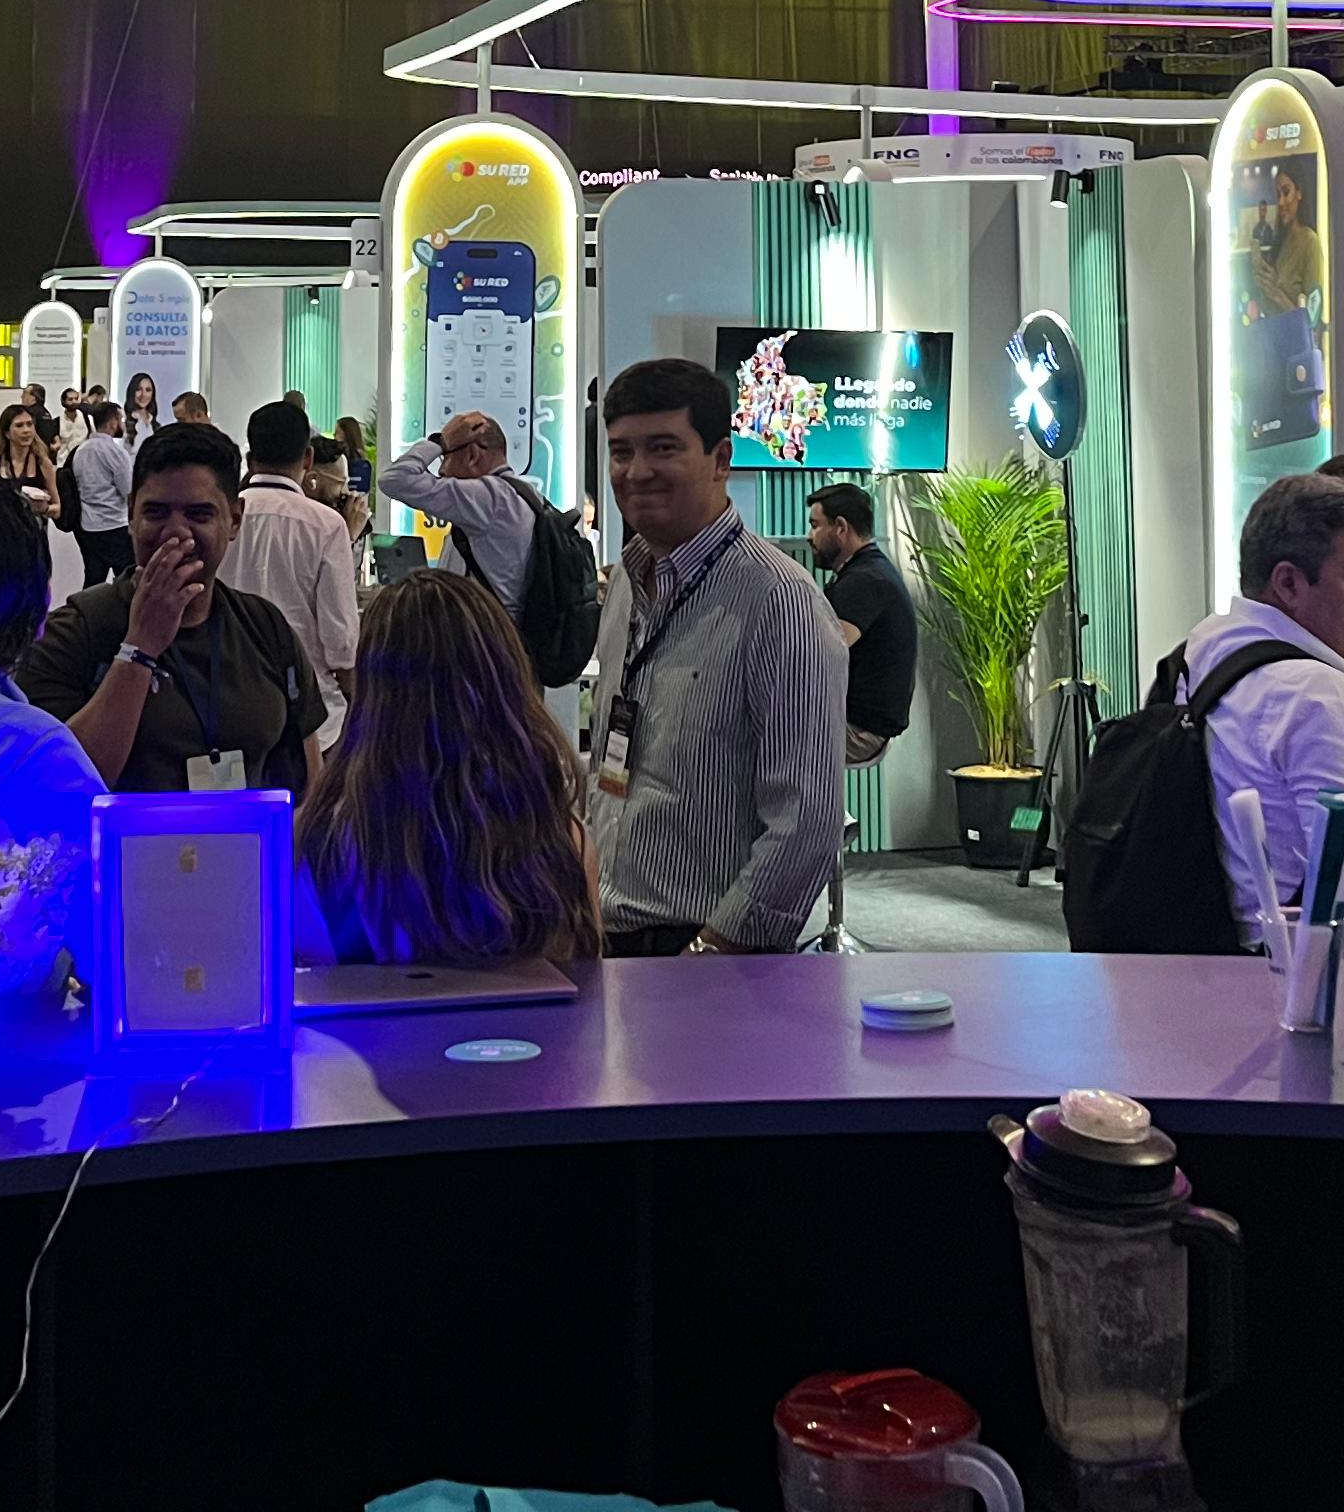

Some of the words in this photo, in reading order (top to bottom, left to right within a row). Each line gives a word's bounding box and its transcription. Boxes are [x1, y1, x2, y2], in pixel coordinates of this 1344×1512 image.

[1279, 123, 1301, 139] RED
[477, 164, 499, 176] SU
[499, 164, 531, 177] RED
[507, 177, 529, 186] APP
[355, 240, 377, 256] 22
[127, 312, 188, 322] CONSULTA
[125, 325, 141, 336] DE
[145, 325, 189, 336] DATOS
[890, 395, 933, 411] nadie
[833, 413, 866, 427] más
